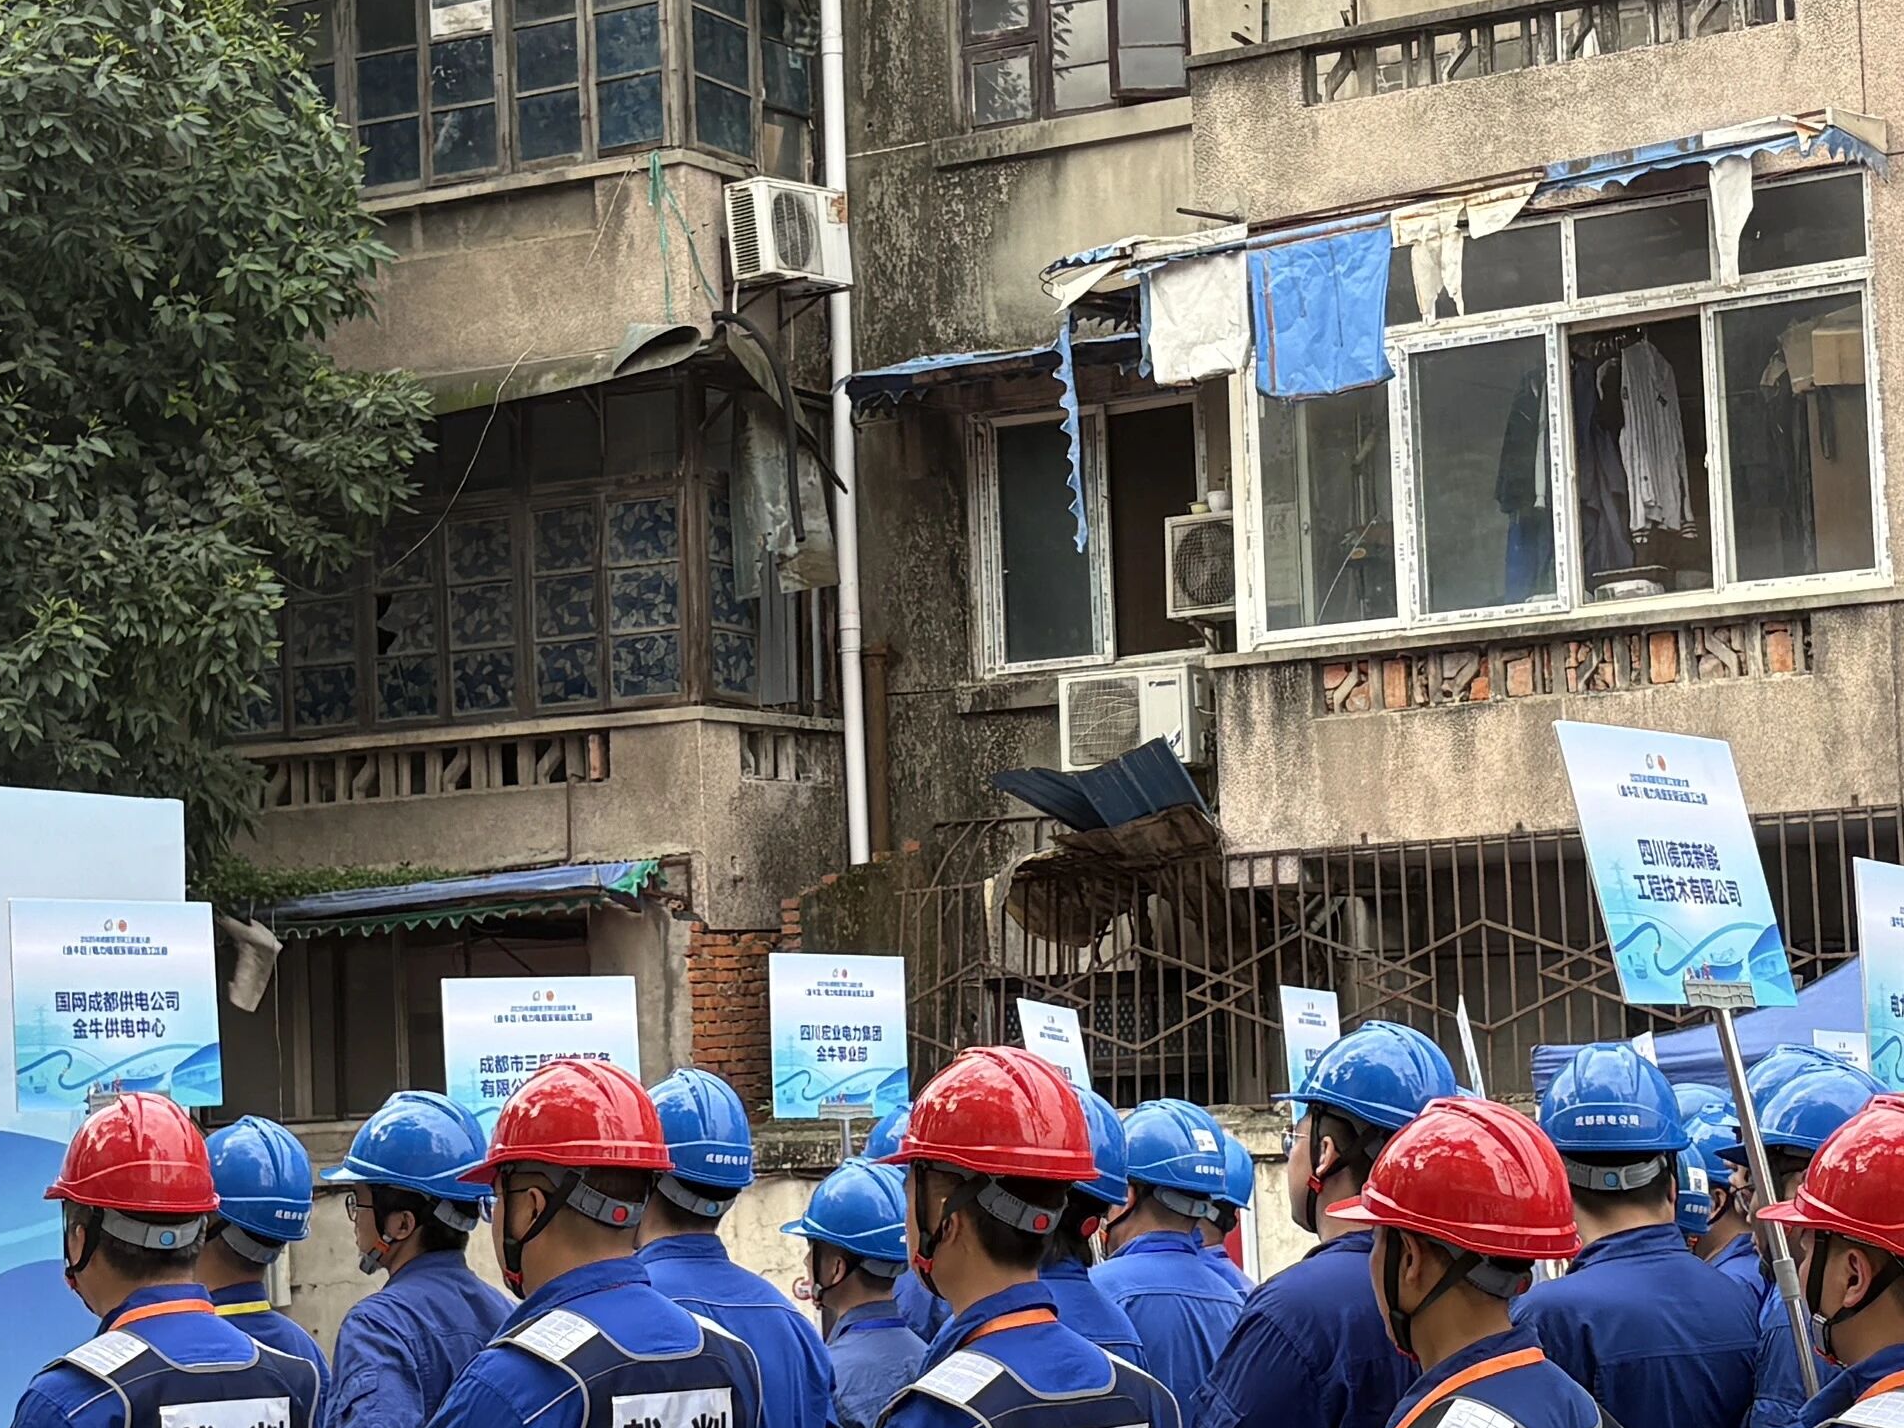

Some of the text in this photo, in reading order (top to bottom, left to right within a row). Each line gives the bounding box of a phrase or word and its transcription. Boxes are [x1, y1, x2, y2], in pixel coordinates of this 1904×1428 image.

[55, 990, 180, 1013] 国网成都供电公司
[72, 1017, 166, 1040] 金牛供电中心
